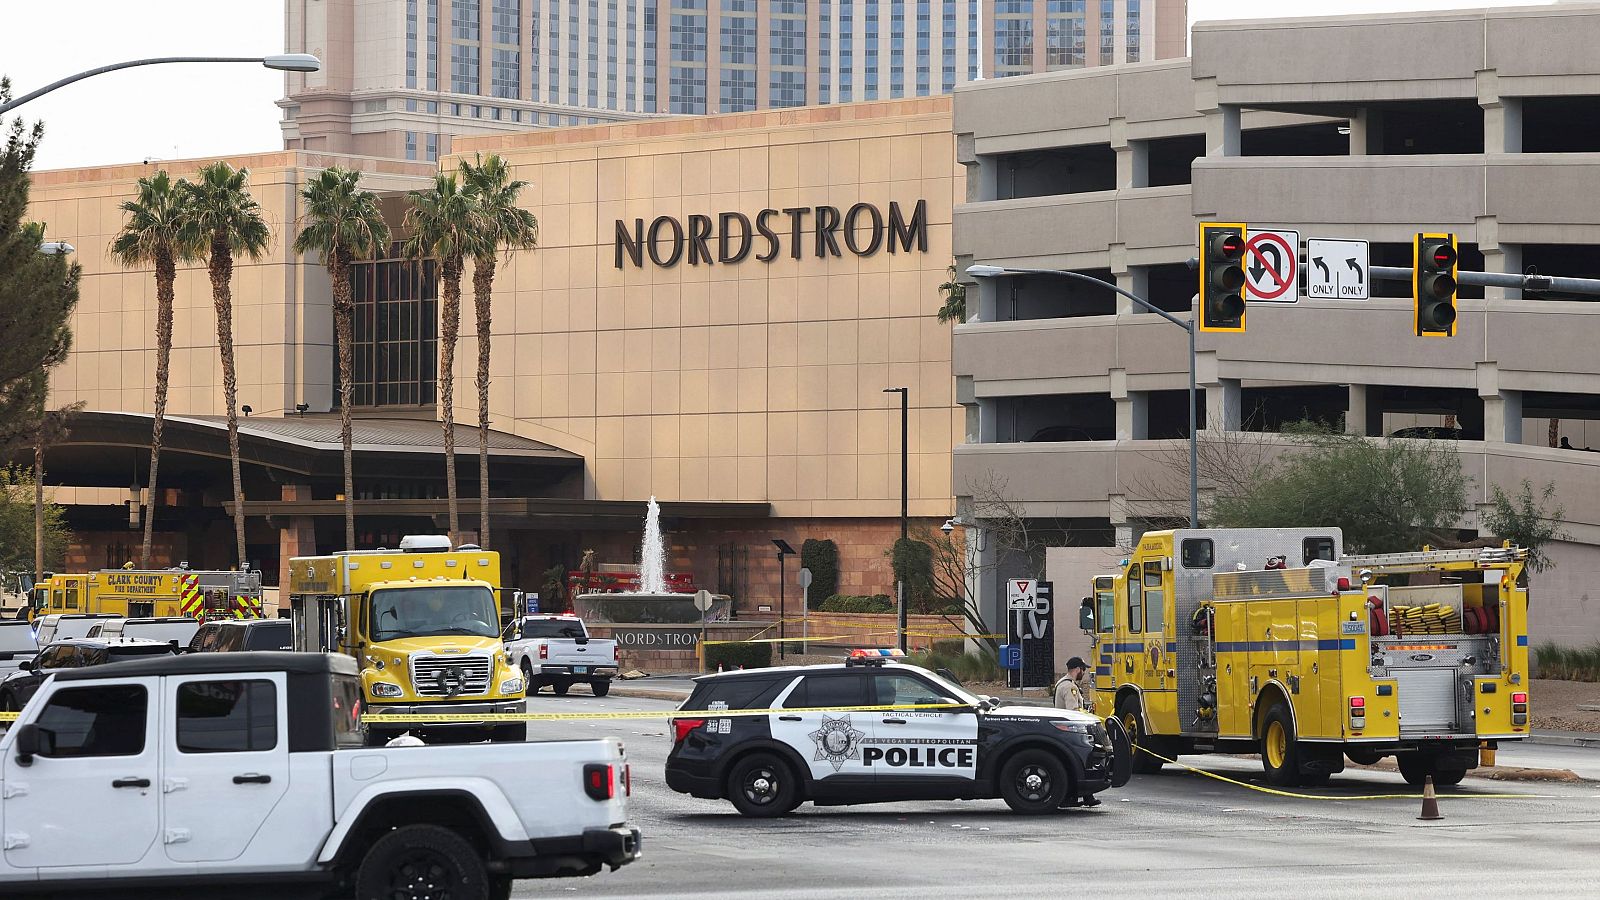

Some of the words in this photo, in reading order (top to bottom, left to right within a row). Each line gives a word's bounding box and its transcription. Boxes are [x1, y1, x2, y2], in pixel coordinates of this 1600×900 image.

[614, 199, 928, 269] NORDSTROM
[1312, 284, 1334, 295] ONLY
[1341, 285, 1363, 296] ONLY
[107, 574, 131, 586] CLARK
[133, 574, 163, 587] COUNTY
[114, 585, 125, 593] FIRE
[126, 585, 157, 594] DEPARTMENT
[1008, 648, 1022, 666] P
[863, 747, 973, 768] POLICE
